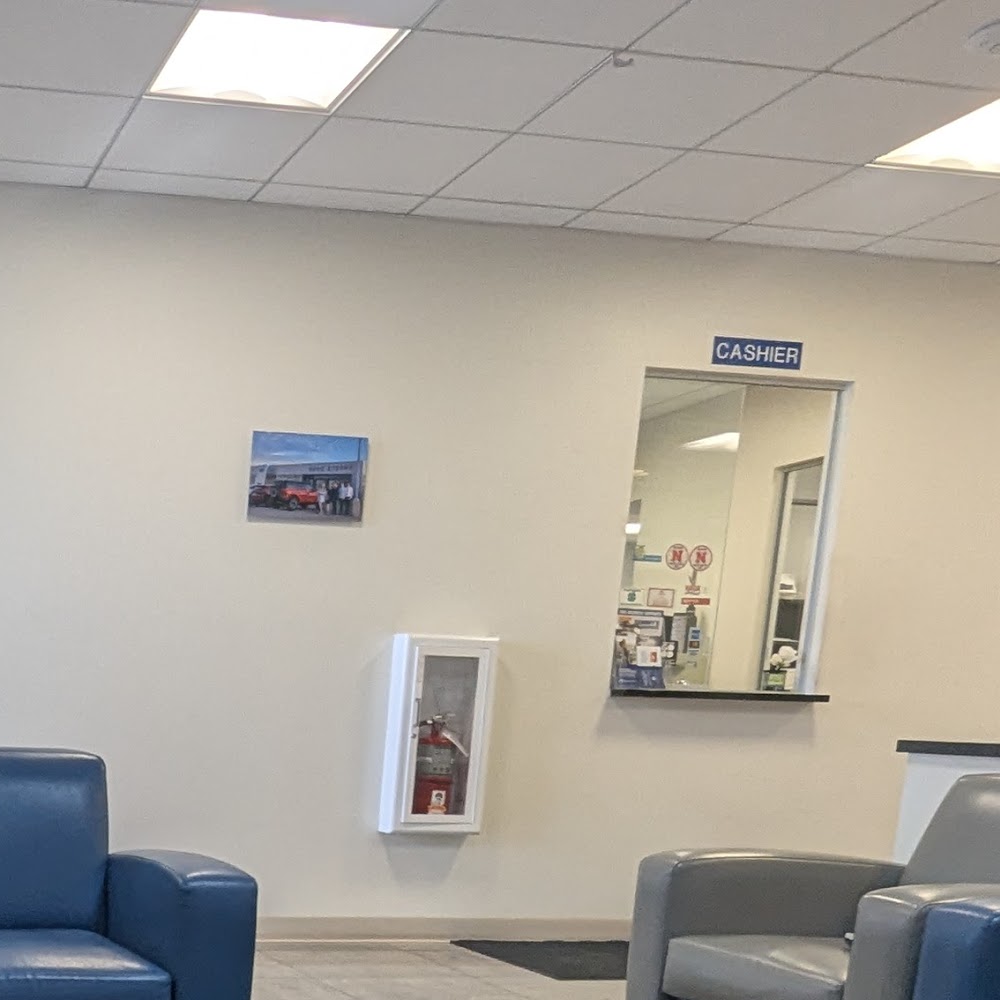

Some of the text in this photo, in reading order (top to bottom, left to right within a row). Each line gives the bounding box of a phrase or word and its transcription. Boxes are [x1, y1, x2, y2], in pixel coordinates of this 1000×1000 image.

[716, 342, 799, 365] CASHIER
[671, 549, 684, 563] N
[694, 551, 706, 564] N
